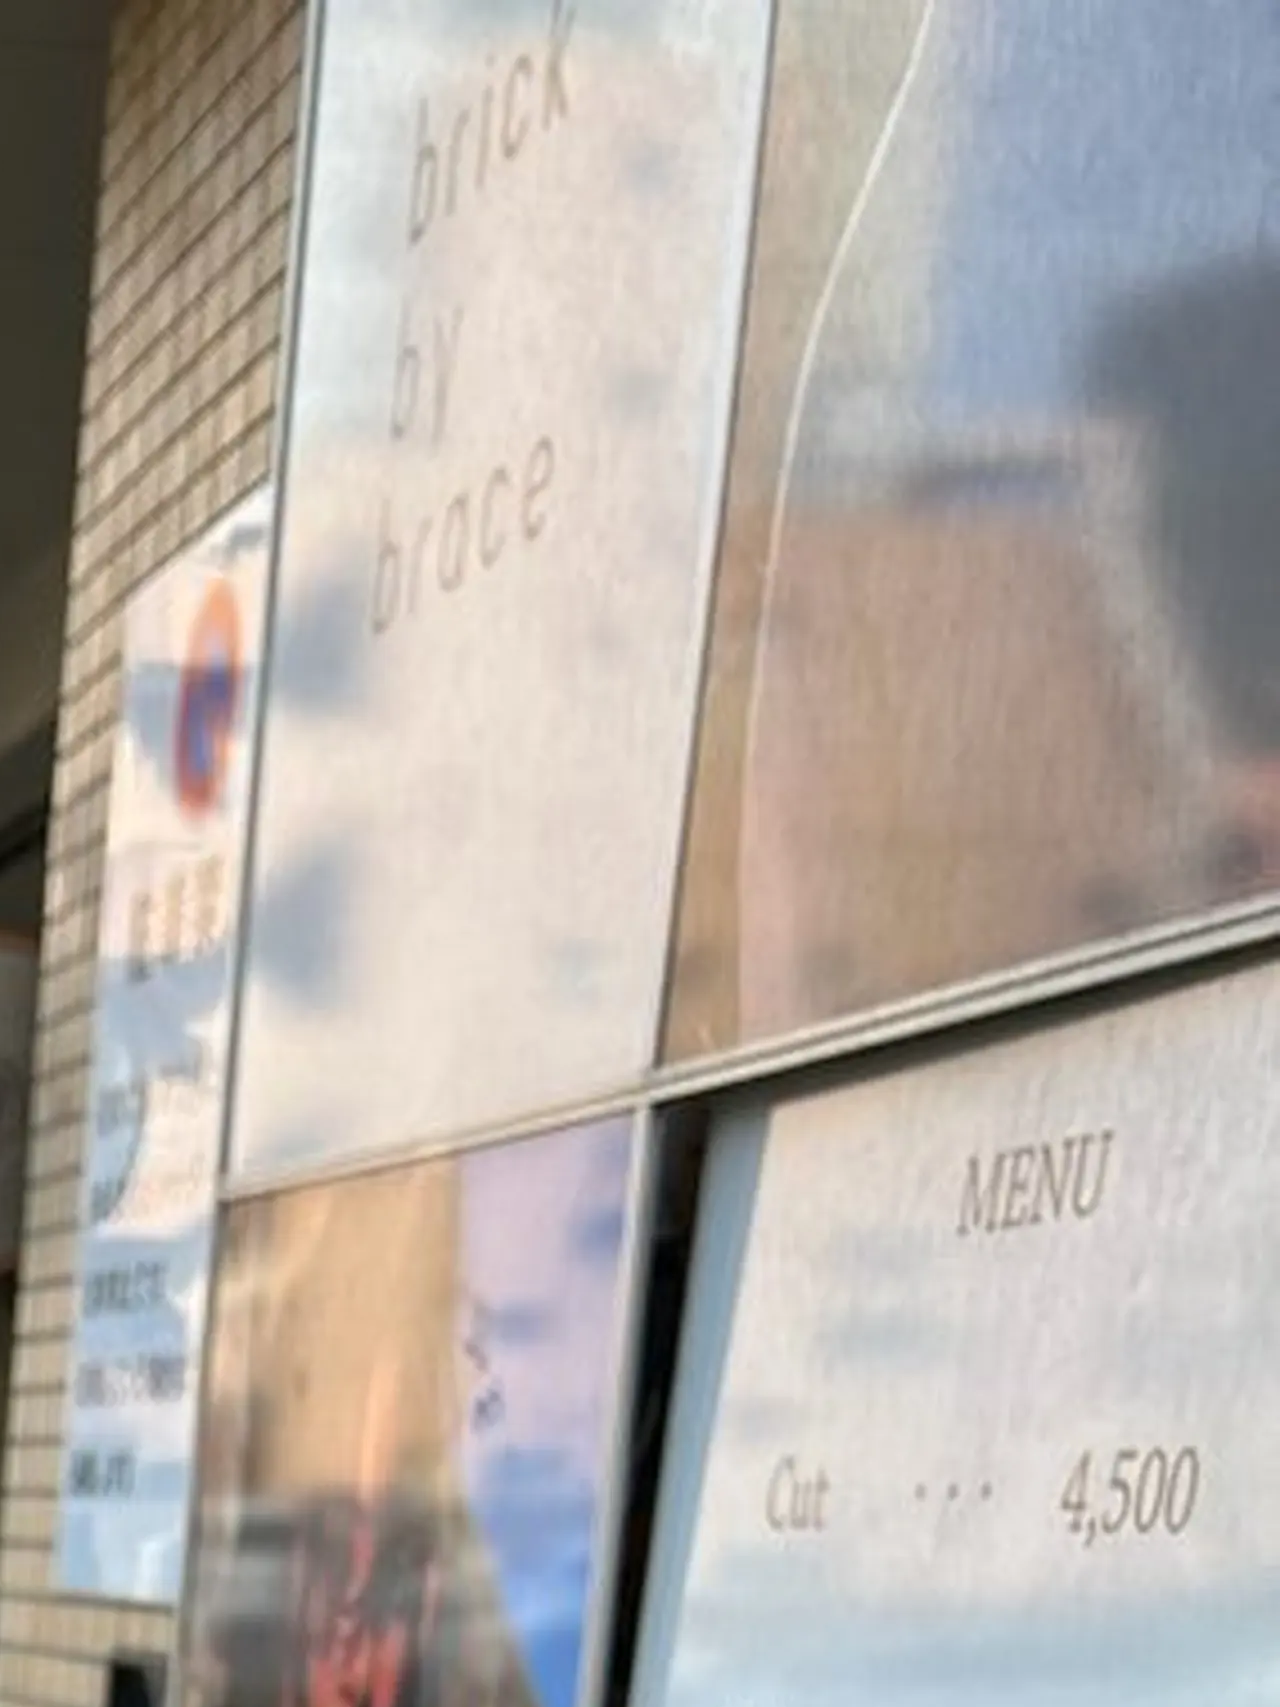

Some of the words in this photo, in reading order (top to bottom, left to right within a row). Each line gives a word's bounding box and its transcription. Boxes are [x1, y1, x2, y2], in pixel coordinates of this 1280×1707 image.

[407, 0, 576, 248] brick
[391, 298, 465, 458] by
[956, 1128, 1115, 1238] MENU
[764, 1454, 830, 1532] Cut
[1059, 1446, 1200, 1548] 4,500
